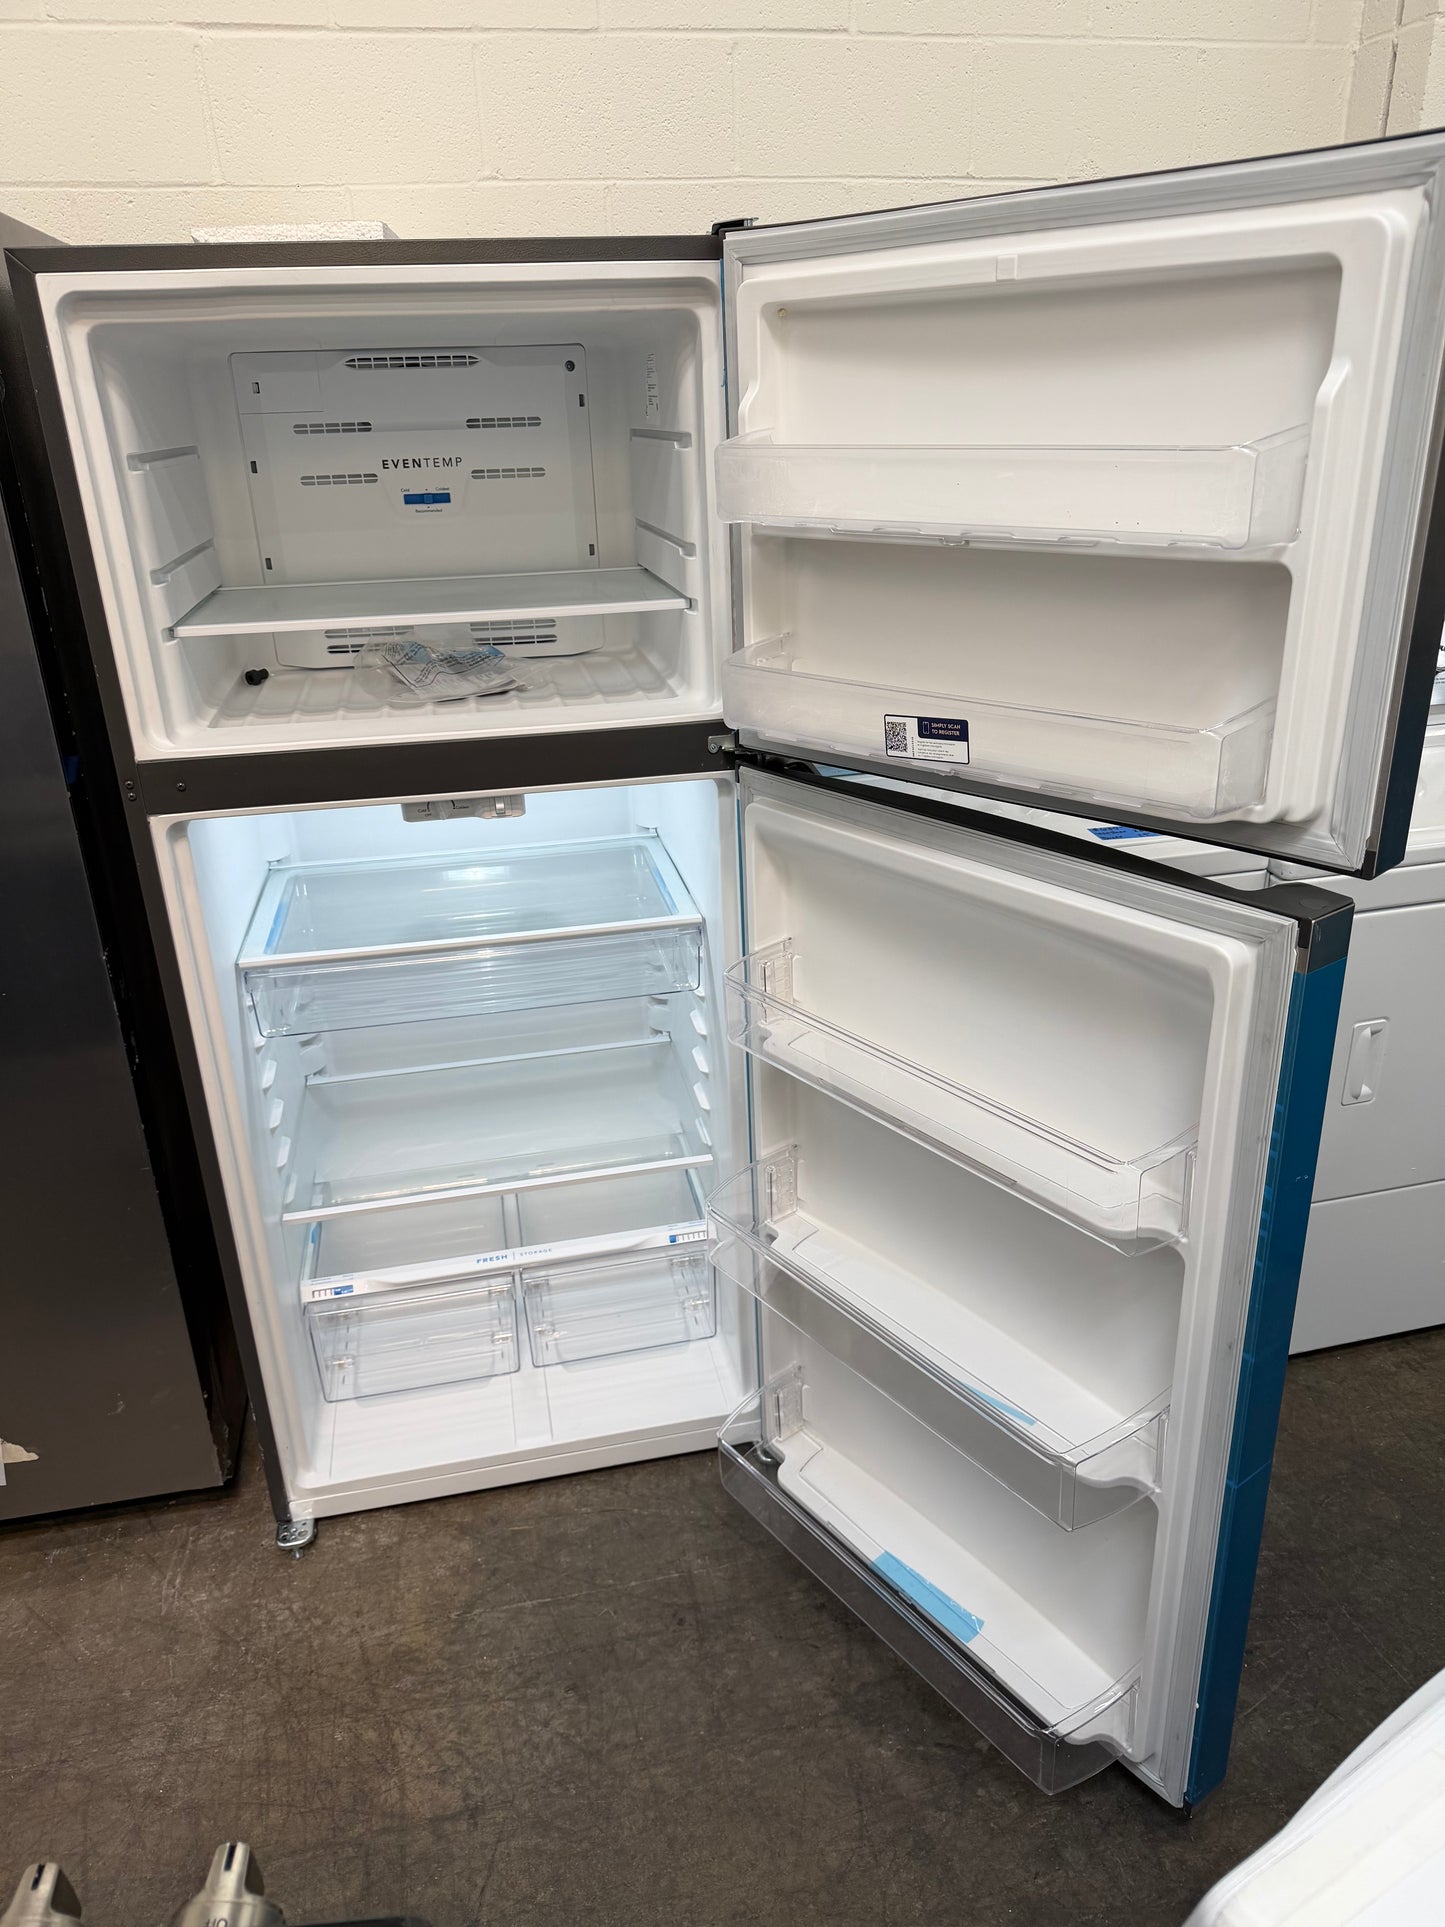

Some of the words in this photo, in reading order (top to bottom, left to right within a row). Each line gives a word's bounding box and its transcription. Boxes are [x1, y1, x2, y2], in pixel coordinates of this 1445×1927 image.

[382, 457, 463, 469] EVENTEMP
[476, 1254, 508, 1264] FRESH
[520, 1248, 552, 1256] STORAGE
